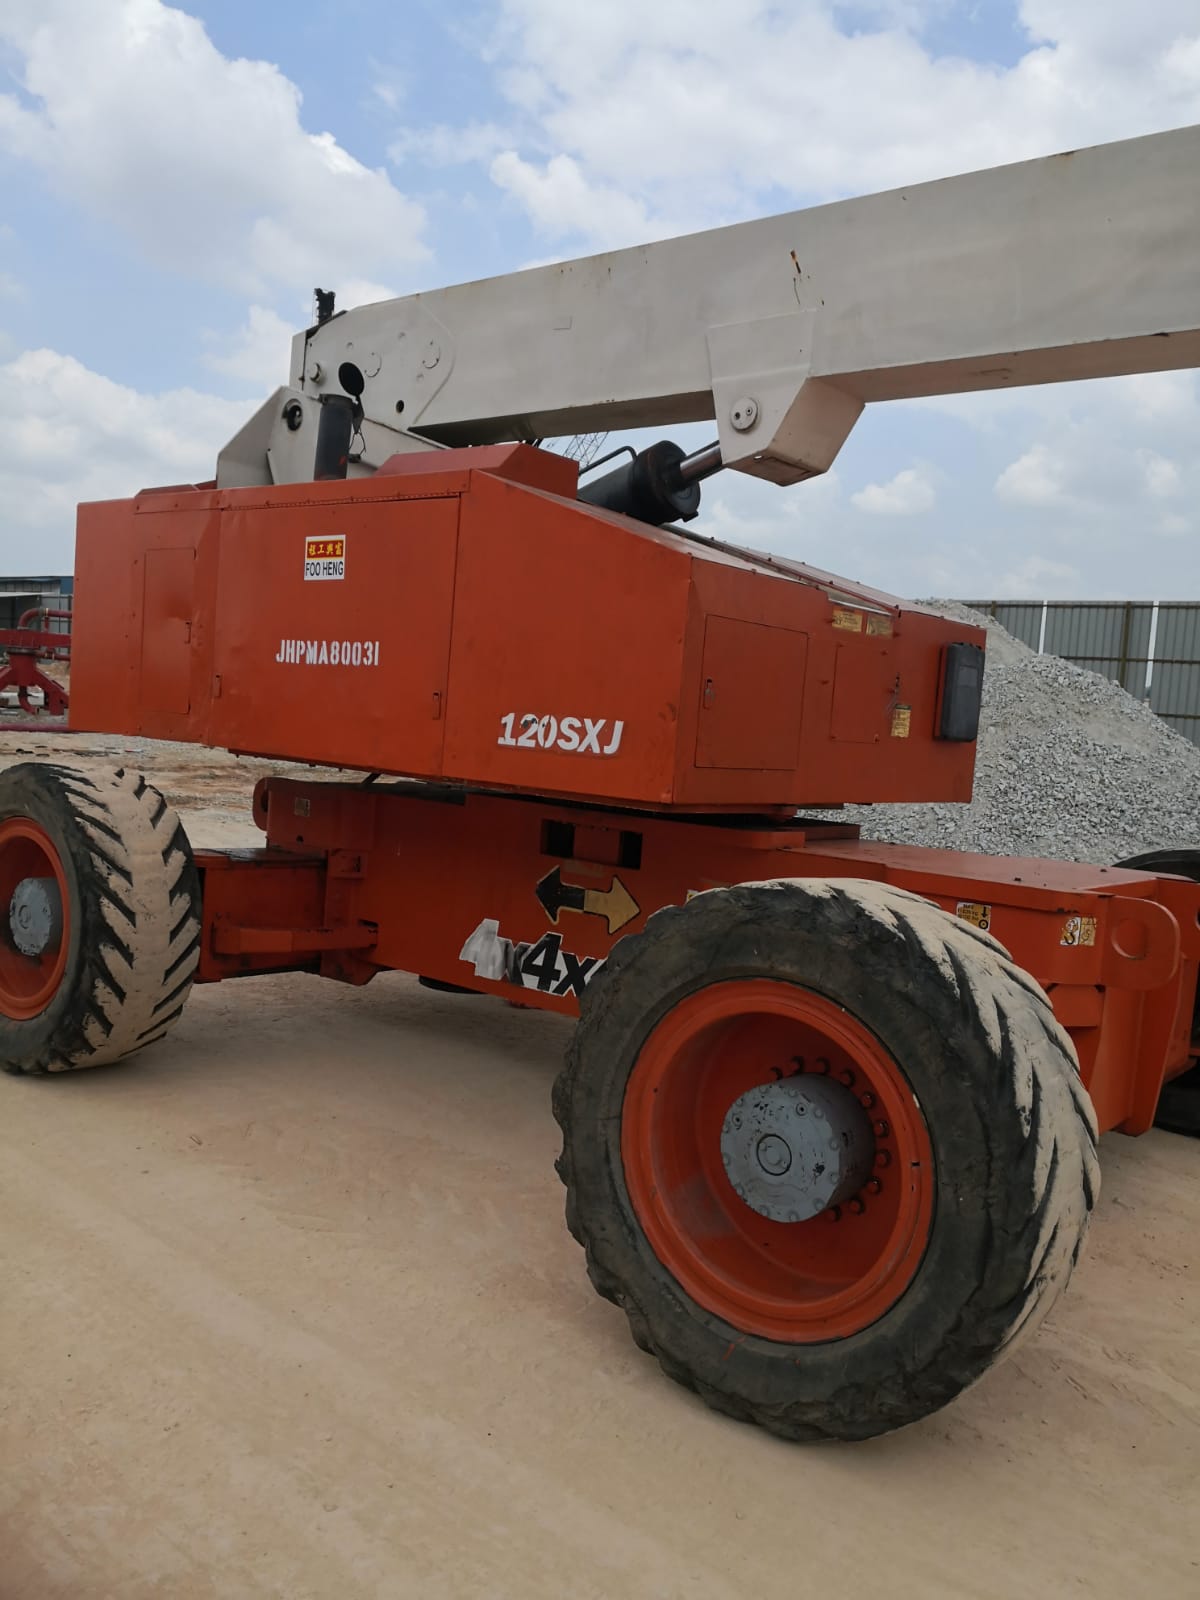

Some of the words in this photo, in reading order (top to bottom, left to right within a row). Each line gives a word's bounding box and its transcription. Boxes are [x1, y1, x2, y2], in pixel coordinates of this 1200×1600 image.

[305, 561, 321, 577] FOO
[322, 560, 344, 576] HENG
[497, 712, 625, 755] 120SXJ
